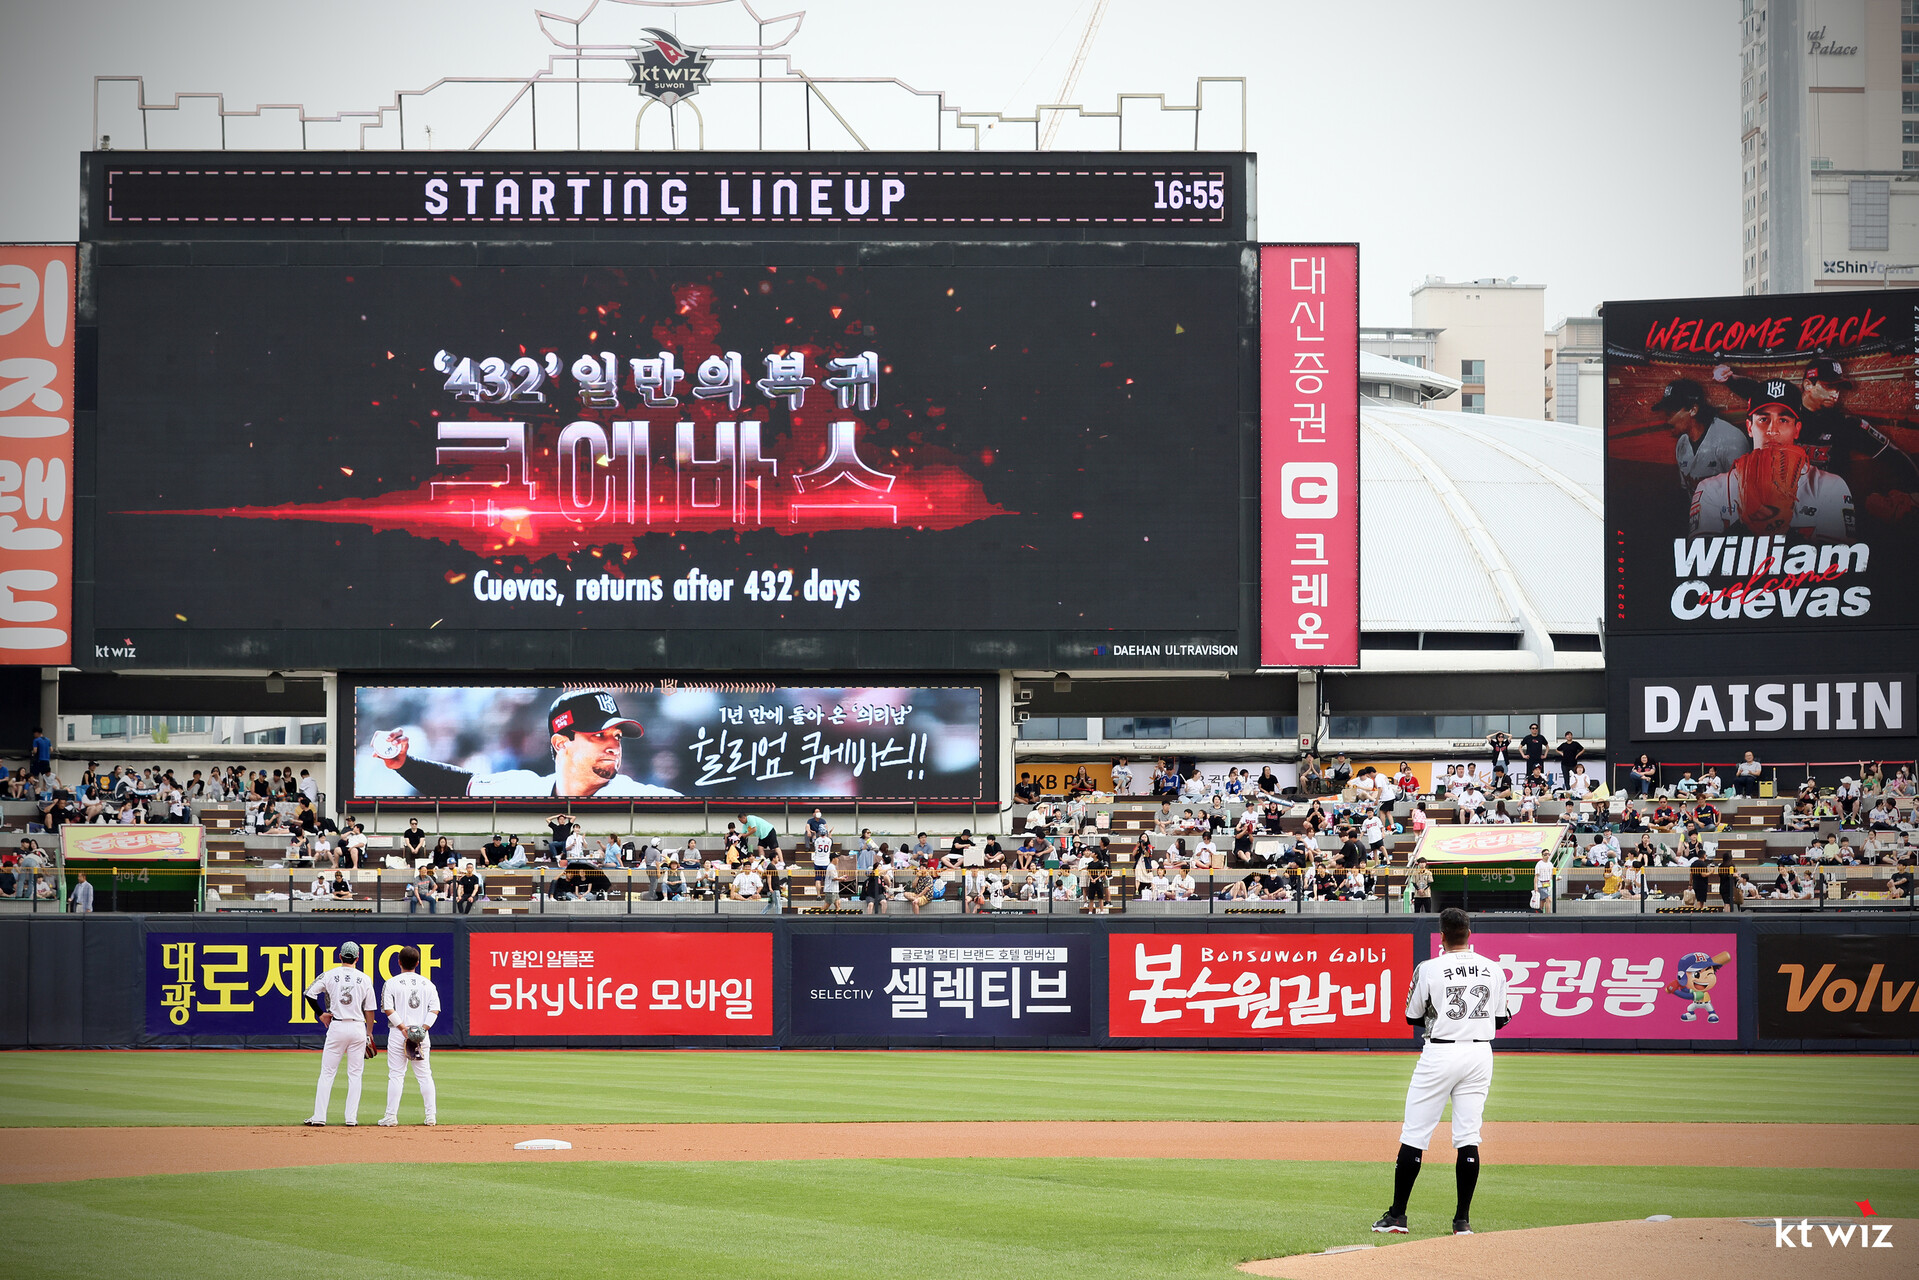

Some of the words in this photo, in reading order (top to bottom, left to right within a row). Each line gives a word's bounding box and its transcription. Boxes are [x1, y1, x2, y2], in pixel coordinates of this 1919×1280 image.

[1808, 41, 1858, 55] Palace
[639, 65, 660, 81] kt
[663, 68, 701, 81] wiz
[424, 178, 688, 215] STARTING
[720, 179, 905, 215] LINEUP
[1154, 180, 1224, 209] 16:55
[1645, 316, 1793, 353] WELCOME
[1796, 308, 1887, 350] BACK
[1289, 256, 1330, 443] 대신증권
[430, 420, 897, 527] 쿠에바스
[1673, 535, 1870, 577] William
[473, 570, 565, 607] Cuevas,
[575, 575, 664, 602] returns
[673, 568, 735, 602] after
[743, 570, 793, 602] 432
[803, 568, 861, 609] days
[1617, 529, 1625, 619] 2023.06.17
[1699, 556, 1848, 606] welcome
[1290, 533, 1330, 650] 크레온
[1670, 580, 1872, 621] Cuevas
[95, 645, 109, 658] kt
[111, 647, 136, 658] wiz
[1113, 645, 1161, 656] DAEHAN
[1165, 645, 1238, 656] ULTRAVISION
[719, 706, 744, 725] 1년
[749, 705, 784, 726] 만에
[788, 706, 825, 726] 돌아
[828, 706, 847, 725] 온
[1644, 681, 1903, 734] DAISHIN
[688, 726, 794, 787] 윌리엄
[817, 844, 830, 854] 50
[137, 867, 150, 884] 4
[1481, 871, 1503, 883] 외야
[1505, 867, 1517, 884] 3
[490, 951, 509, 967] TV
[511, 950, 543, 968] 할인
[546, 950, 595, 968] 알뜰폰
[902, 949, 935, 962] 글로벌
[938, 948, 959, 962] 멀티
[963, 949, 995, 961] 브랜드
[999, 948, 1020, 962] 호텔
[1023, 948, 1056, 962] 멤버십
[1201, 946, 1318, 964] Bonsuwon
[1328, 947, 1387, 963] Galbi
[1128, 943, 1392, 1029] 본수원갈비
[1443, 965, 1491, 980] 쿠에바스
[339, 985, 353, 1006] 3
[408, 989, 421, 1009] 6
[489, 976, 638, 1017] skylife
[649, 978, 753, 1020] 모바일
[810, 989, 874, 1000] SELECTIV
[883, 966, 1072, 1019] 셀렉티브
[1446, 984, 1491, 1020] 32
